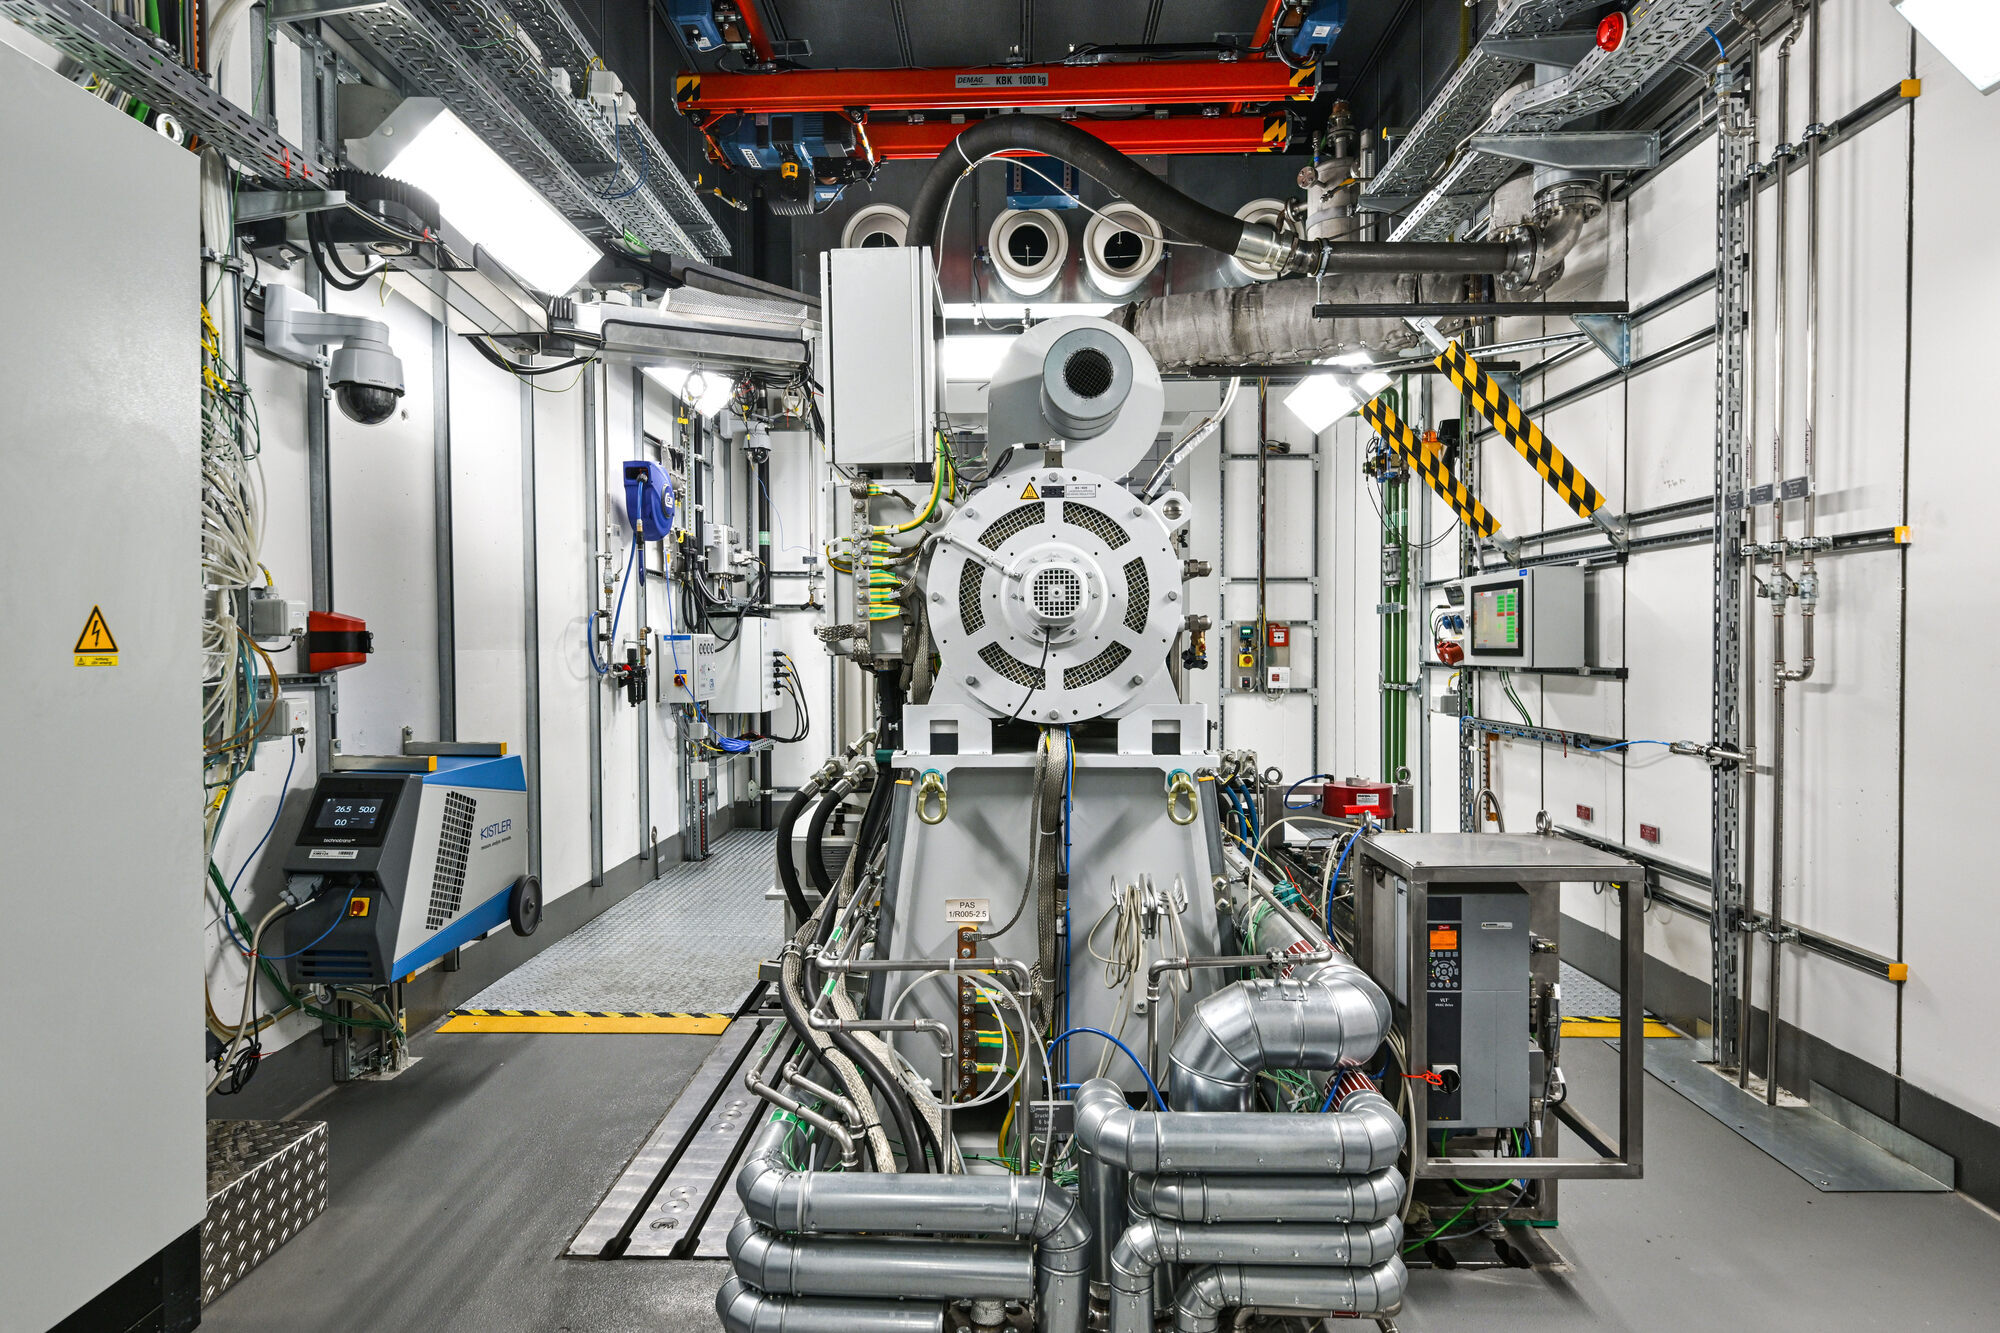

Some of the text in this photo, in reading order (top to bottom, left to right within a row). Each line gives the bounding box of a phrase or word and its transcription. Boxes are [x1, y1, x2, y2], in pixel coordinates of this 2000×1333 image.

[957, 75, 1047, 86] DEMAG KBK 1000 kg
[334, 805, 352, 813] 26.5
[480, 818, 512, 840] KISTLER
[959, 901, 976, 909] PAS
[949, 910, 987, 918] 1/R005-2.5
